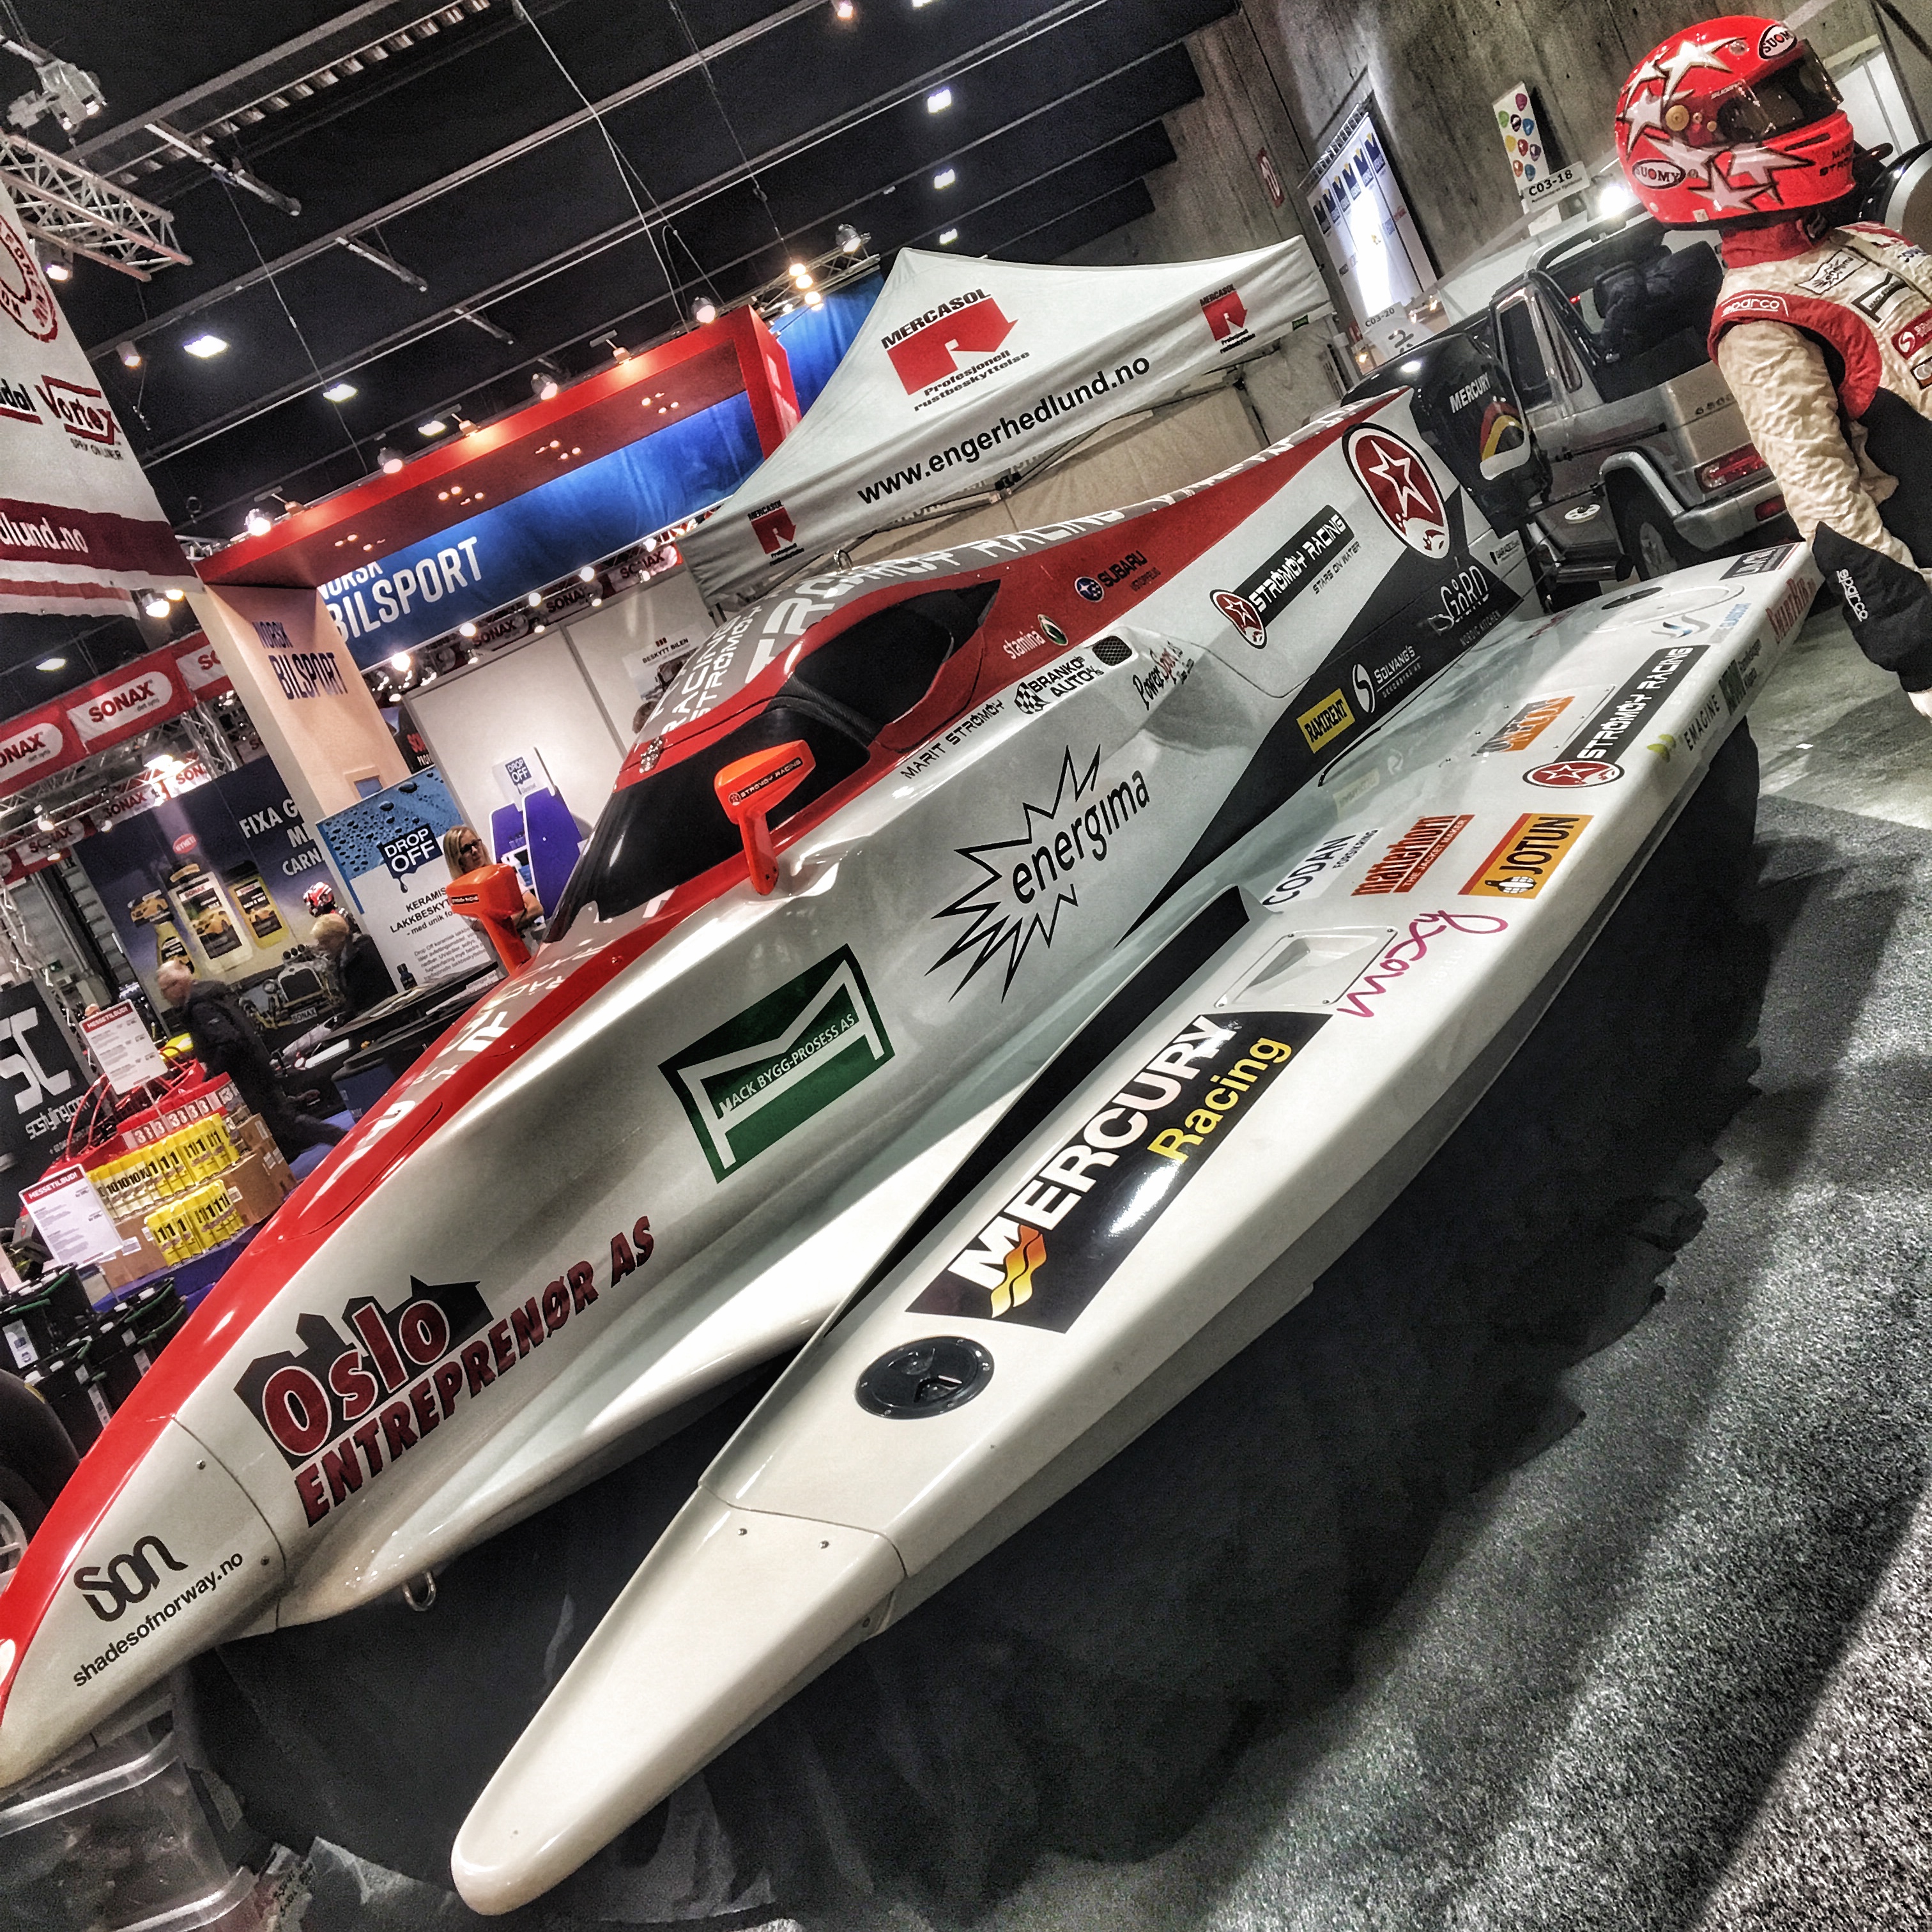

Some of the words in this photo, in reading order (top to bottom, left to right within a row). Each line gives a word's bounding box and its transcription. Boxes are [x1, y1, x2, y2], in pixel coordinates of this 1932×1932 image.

[1761, 30, 1794, 54] SUOM
[1529, 169, 1573, 196] C03-18
[1634, 164, 1682, 186] SUOMY
[881, 288, 992, 349] MERCASOL
[1365, 307, 1395, 328] C03-20
[914, 351, 1031, 412] rustbeskyttelse
[924, 349, 1011, 396] Profesjonell
[1449, 372, 1491, 413] MERCURY
[34, 383, 123, 434] Vortex
[857, 355, 1151, 505] www.engerhedlund.no
[1302, 512, 1347, 562] RACING
[326, 535, 483, 643] BILSPORT
[1097, 550, 1148, 587] SUBARU
[1311, 572, 1335, 597] STARS
[1341, 542, 1362, 564] WATER
[1836, 569, 1868, 622] sparco
[252, 621, 293, 649] NORSK
[1002, 626, 1046, 659] stamina
[1459, 627, 1480, 647] NORDIC
[1479, 609, 1501, 631] KITCHEN
[642, 647, 670, 664] BESKYTT
[670, 638, 690, 652] BILEN
[1648, 645, 1694, 690] RACING
[268, 652, 349, 700] BILSPORT
[88, 680, 155, 723] SONAX
[1304, 698, 1348, 744] RAMIRENT
[1683, 694, 1721, 753] EMAGINE
[175, 763, 206, 786] SON
[507, 759, 524, 772] DROP
[511, 767, 528, 783] OFF
[900, 744, 946, 779] MARIT
[238, 806, 284, 839] FIXA
[384, 828, 429, 858] DROP
[1012, 770, 1150, 904] energima
[282, 848, 326, 877] CARN
[391, 839, 435, 872] OFF
[1332, 829, 1378, 870] FORSIKRING
[1402, 872, 1422, 887] THE
[1417, 844, 1445, 871] JACKET
[1442, 819, 1468, 843] MAKER
[1499, 816, 1581, 875] JOTUN
[1262, 833, 1358, 906] CODAN
[390, 898, 451, 933] LAKKBESKYT
[405, 887, 447, 912] KERAMIS
[411, 923, 427, 935] med
[428, 914, 445, 926] unik
[445, 909, 454, 919] fo
[1337, 910, 1508, 1018] moxy
[717, 1081, 756, 1113] MACK
[756, 1023, 839, 1089] BYGG-PROSESS
[836, 1013, 856, 1033] AS
[1147, 1037, 1292, 1163] Racing
[947, 1015, 1238, 1292] MERCURY
[262, 1299, 450, 1457] Oslo
[294, 1260, 599, 1528] ENTREPRENØR
[610, 1215, 655, 1288] AS
[73, 1535, 188, 1621] son
[73, 1552, 243, 1687] shadesofnorway.no
